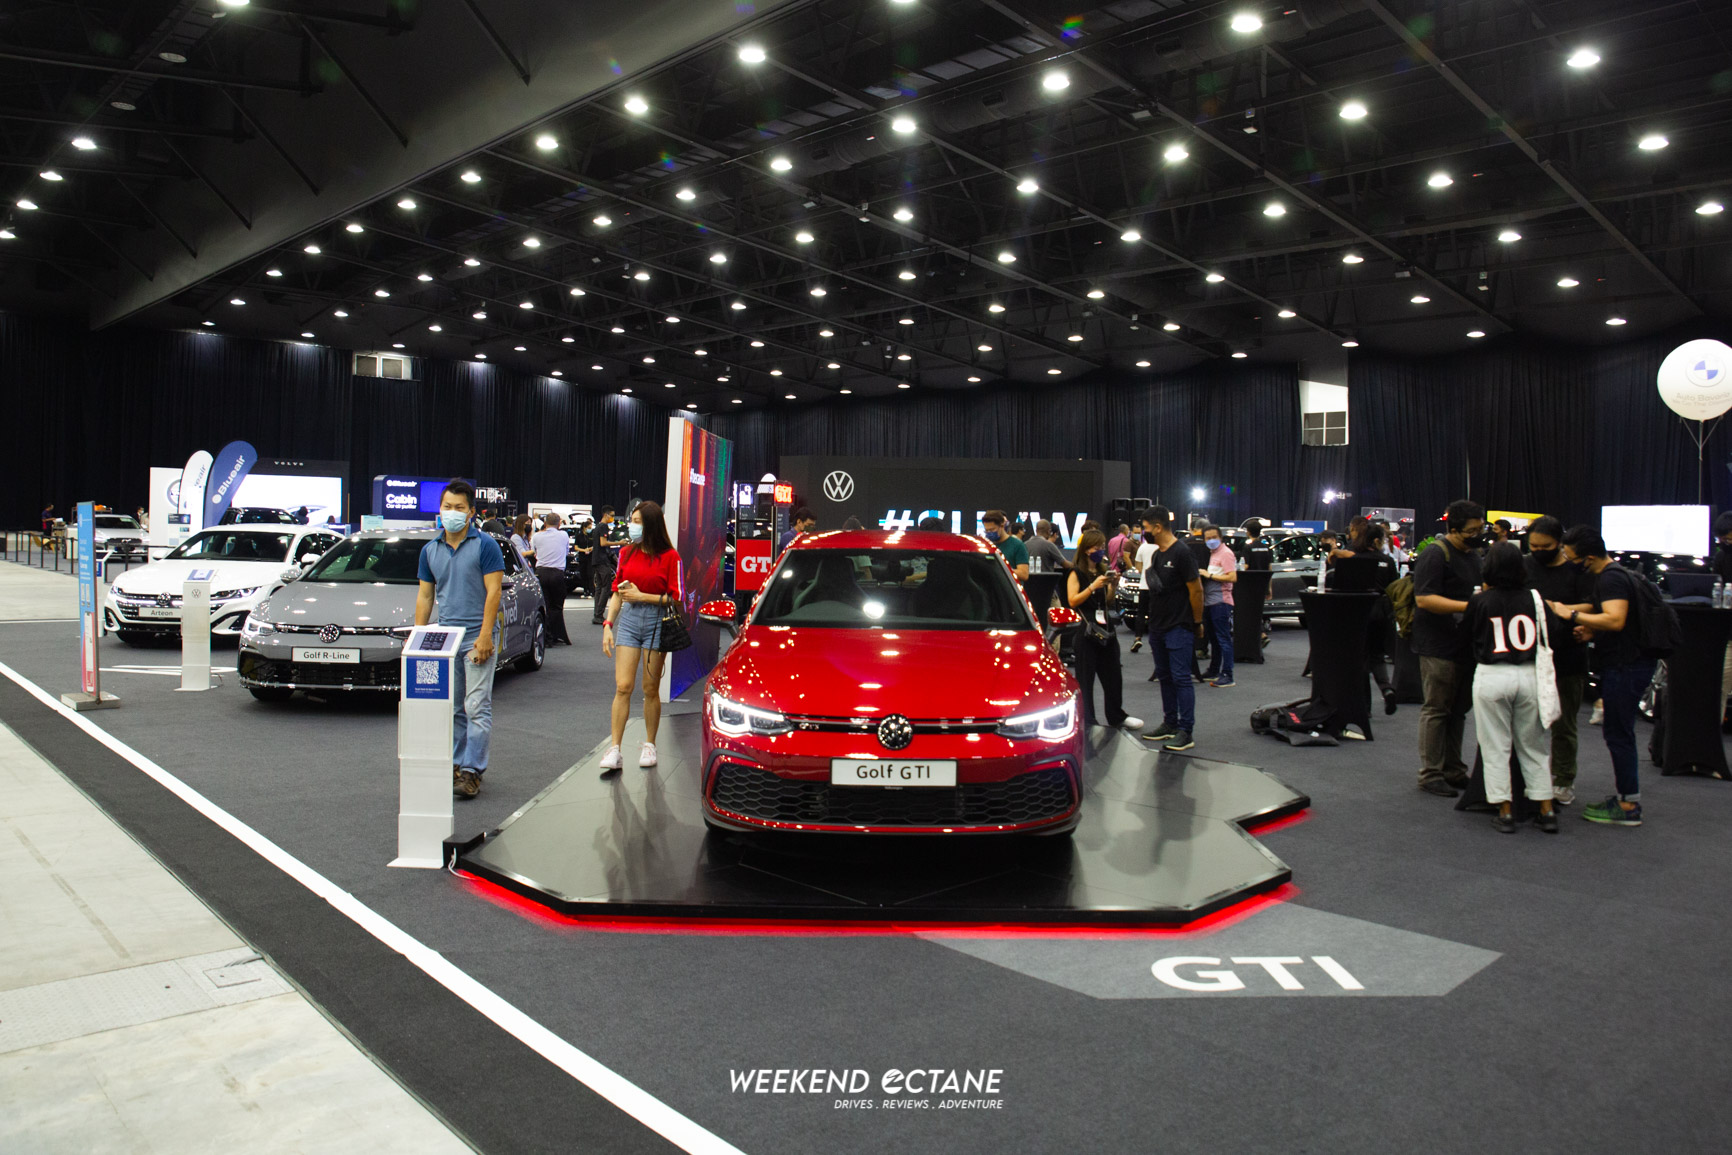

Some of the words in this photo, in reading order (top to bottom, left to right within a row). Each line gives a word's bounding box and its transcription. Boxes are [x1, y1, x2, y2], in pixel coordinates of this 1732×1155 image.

[386, 493, 418, 505] Cabin
[1490, 614, 1536, 653] 10
[303, 651, 321, 659] Golf
[322, 652, 350, 660] R-Line
[856, 764, 893, 779] Golf
[900, 765, 931, 780] GTI
[1151, 956, 1365, 992] GTI
